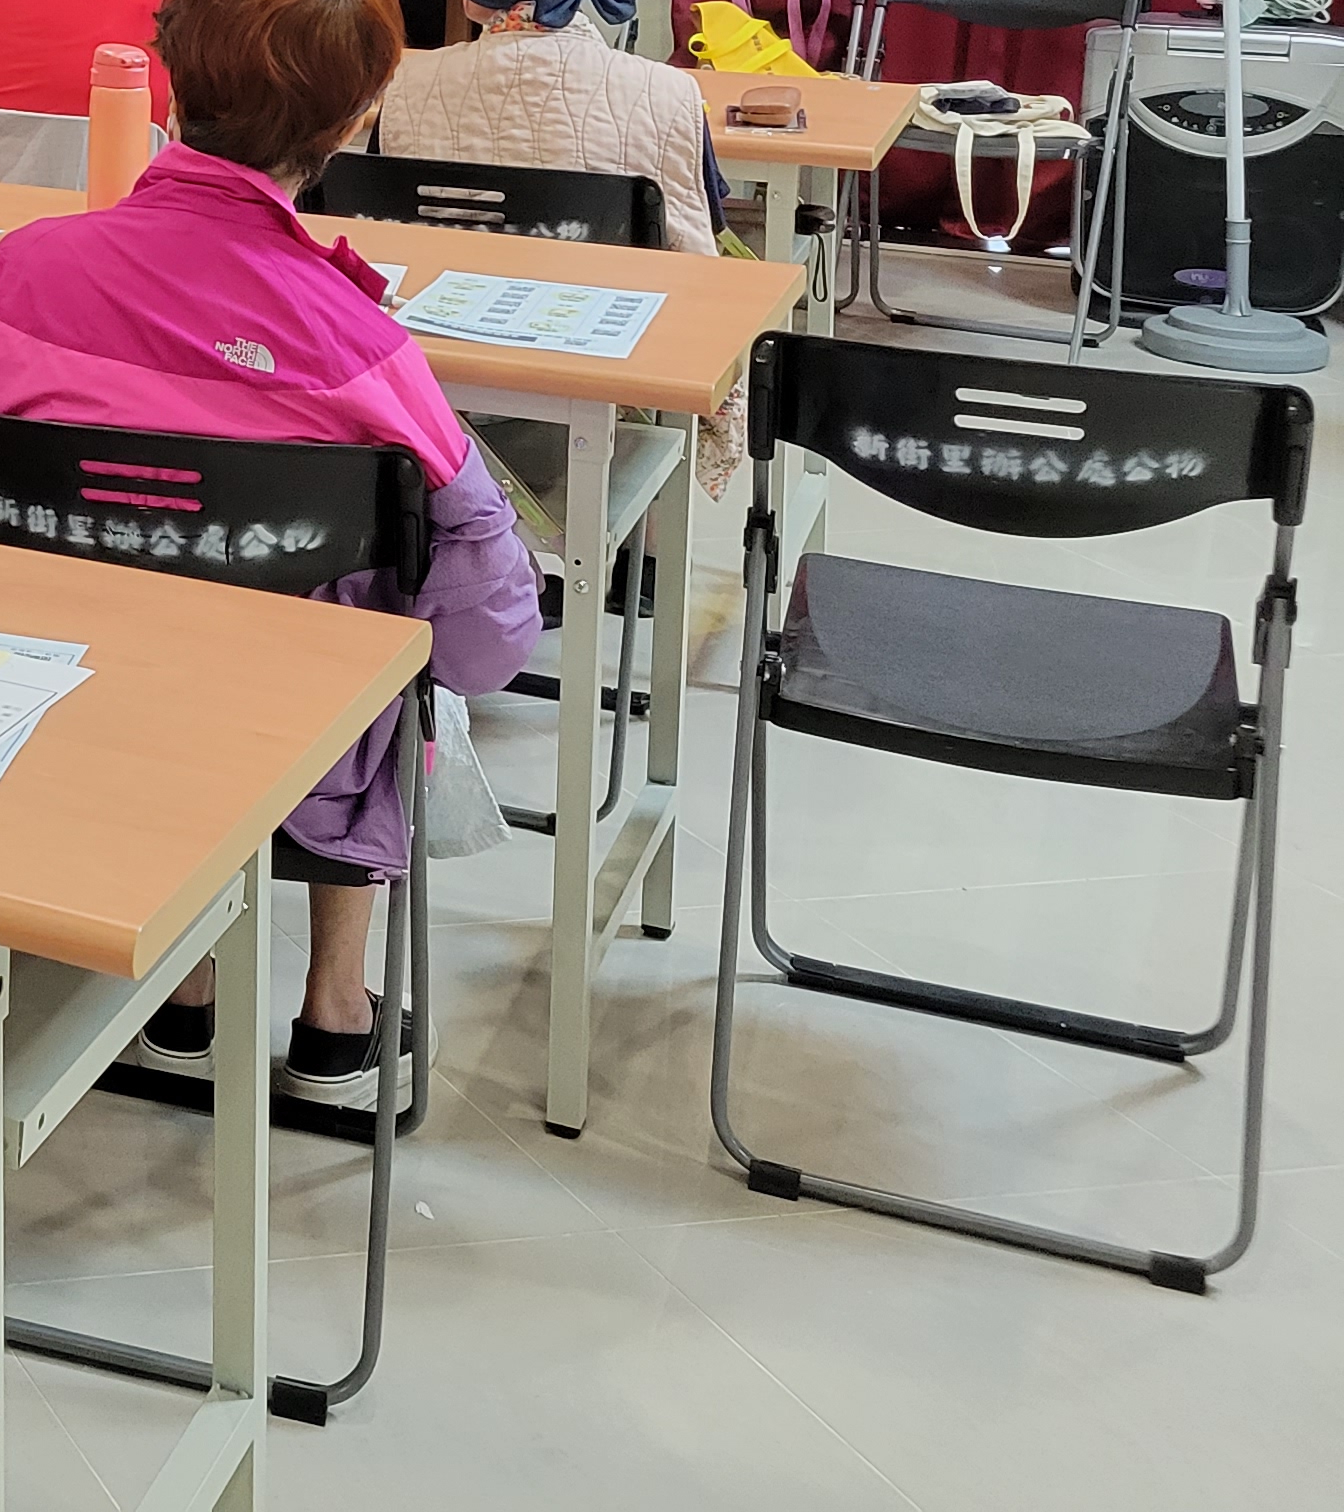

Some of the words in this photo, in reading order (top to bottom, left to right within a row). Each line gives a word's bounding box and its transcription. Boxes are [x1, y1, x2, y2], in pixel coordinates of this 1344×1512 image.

[214, 341, 256, 361] NORTH
[234, 337, 259, 353] THE
[224, 352, 255, 369] FACE
